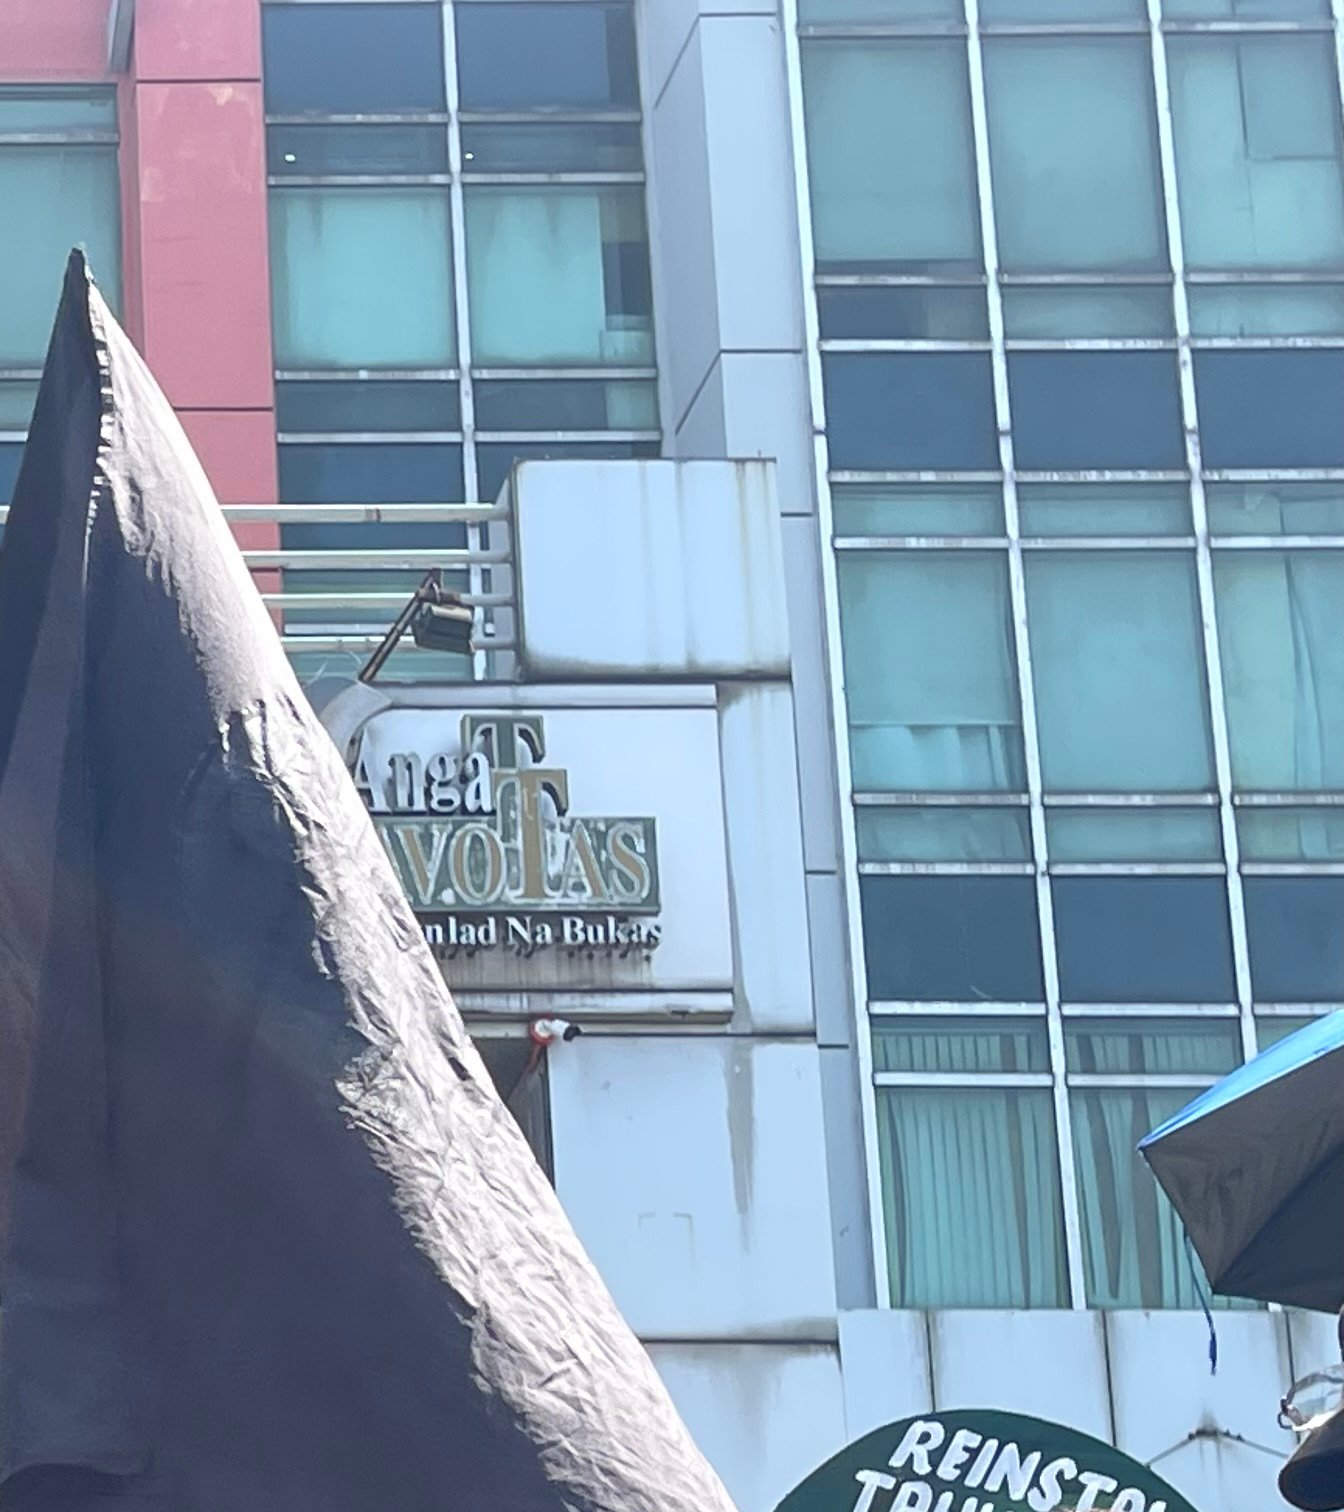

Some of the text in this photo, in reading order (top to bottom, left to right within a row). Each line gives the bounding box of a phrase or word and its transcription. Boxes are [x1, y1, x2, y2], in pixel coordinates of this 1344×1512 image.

[380, 768, 653, 904] VOTAS
[505, 915, 553, 947] Na
[562, 915, 663, 949] Bukas
